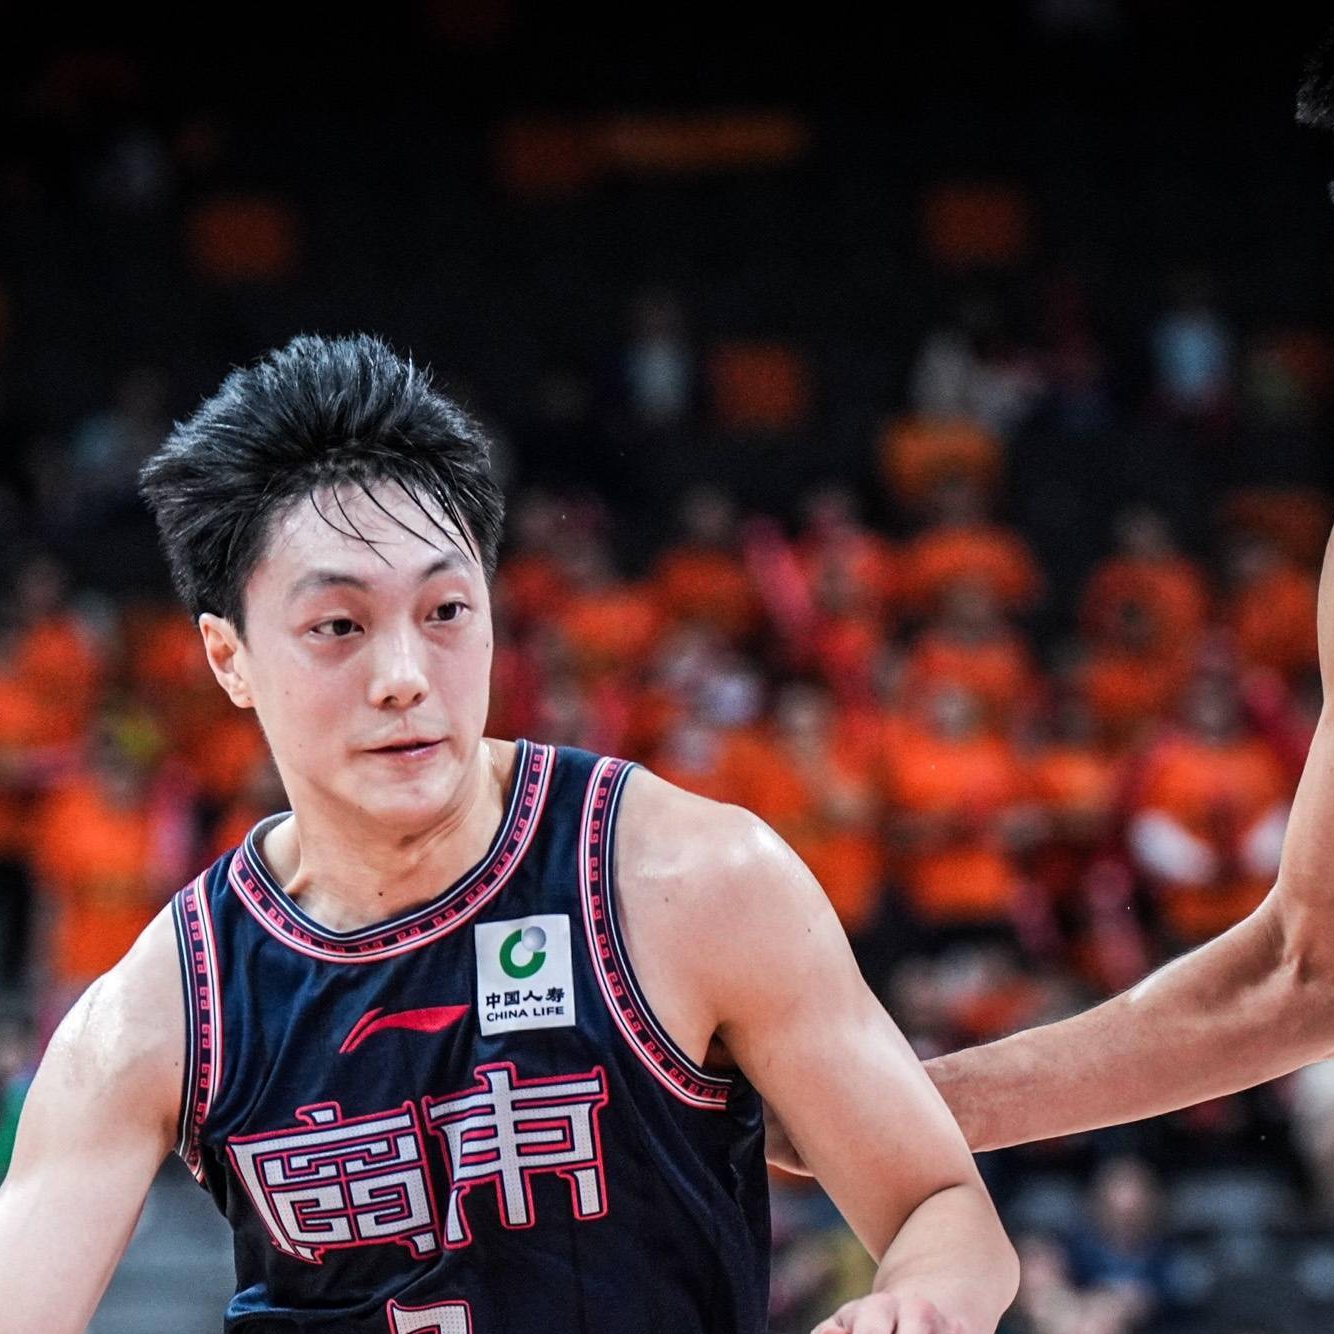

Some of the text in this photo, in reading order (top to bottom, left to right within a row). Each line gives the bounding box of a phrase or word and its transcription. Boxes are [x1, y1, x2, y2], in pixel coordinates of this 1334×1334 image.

[486, 987, 565, 1010] 中国人寿
[486, 1006, 565, 1022] CHINA LIFE
